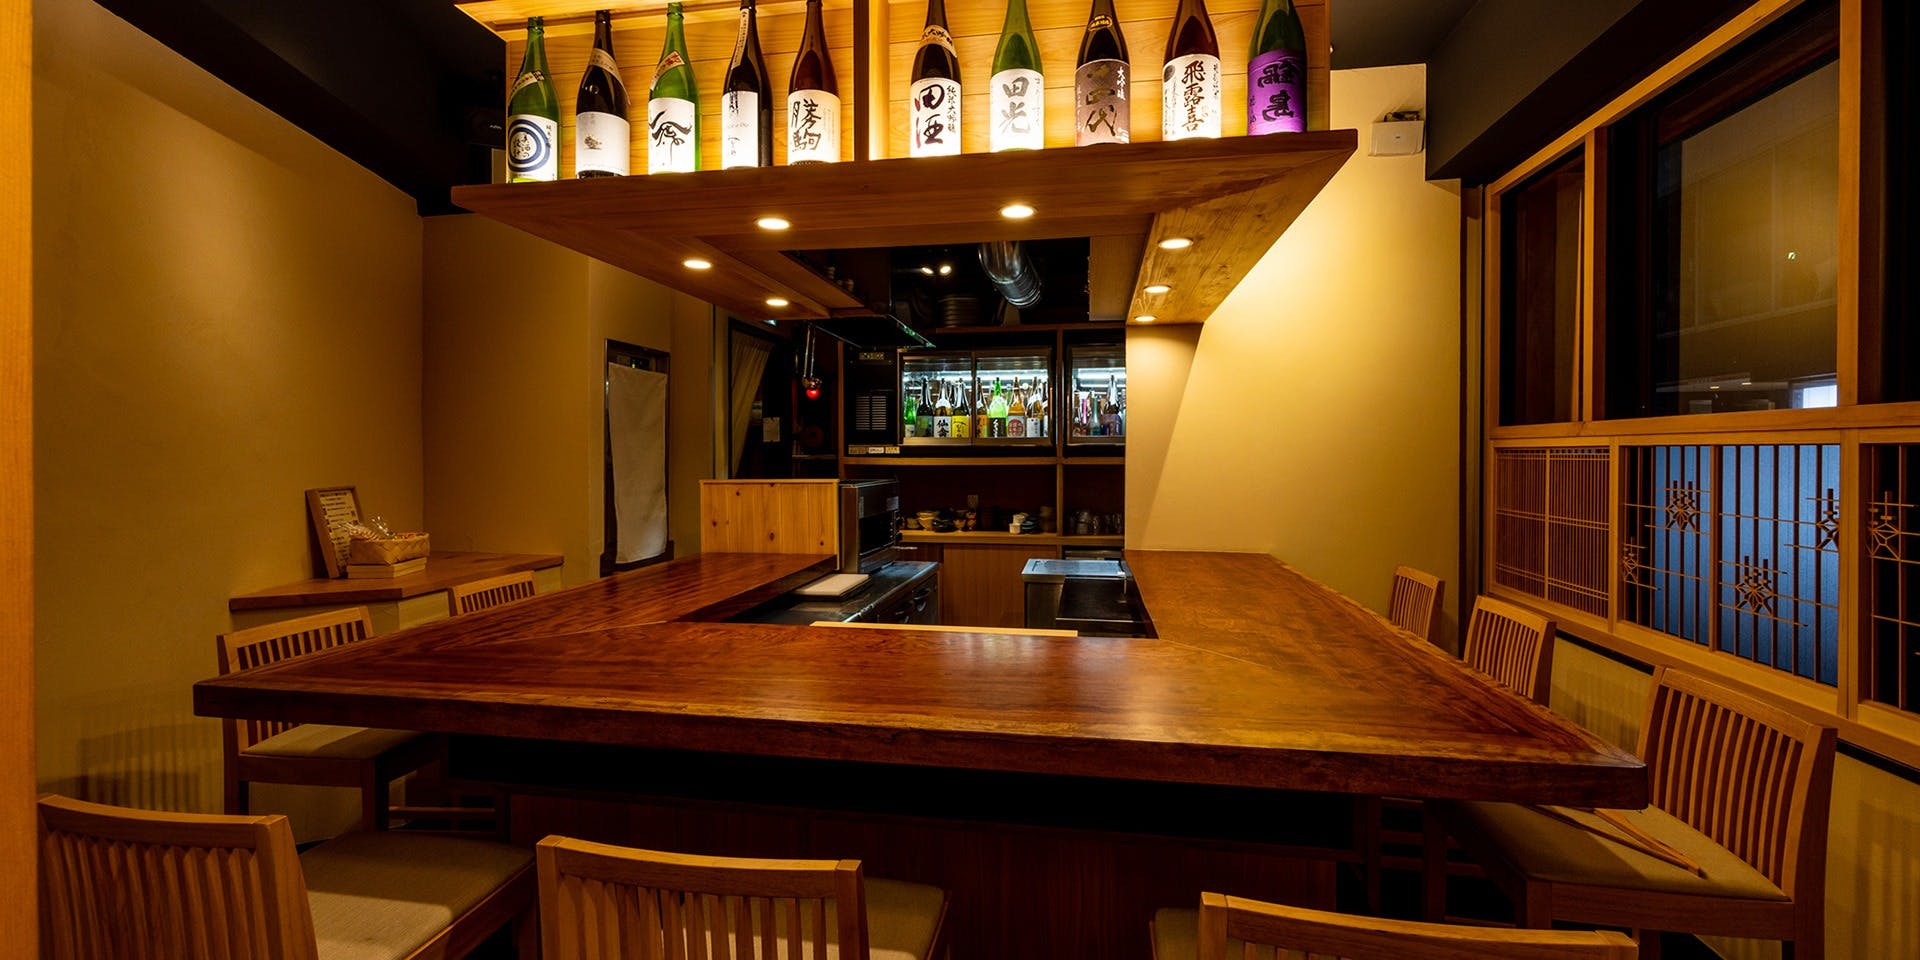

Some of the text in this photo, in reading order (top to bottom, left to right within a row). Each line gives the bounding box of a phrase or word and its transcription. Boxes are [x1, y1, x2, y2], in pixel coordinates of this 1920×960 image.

[791, 98, 822, 153] 勝駒
[914, 84, 946, 149] 田酒
[998, 76, 1032, 134] 田光
[1181, 60, 1206, 132] 飛露喜
